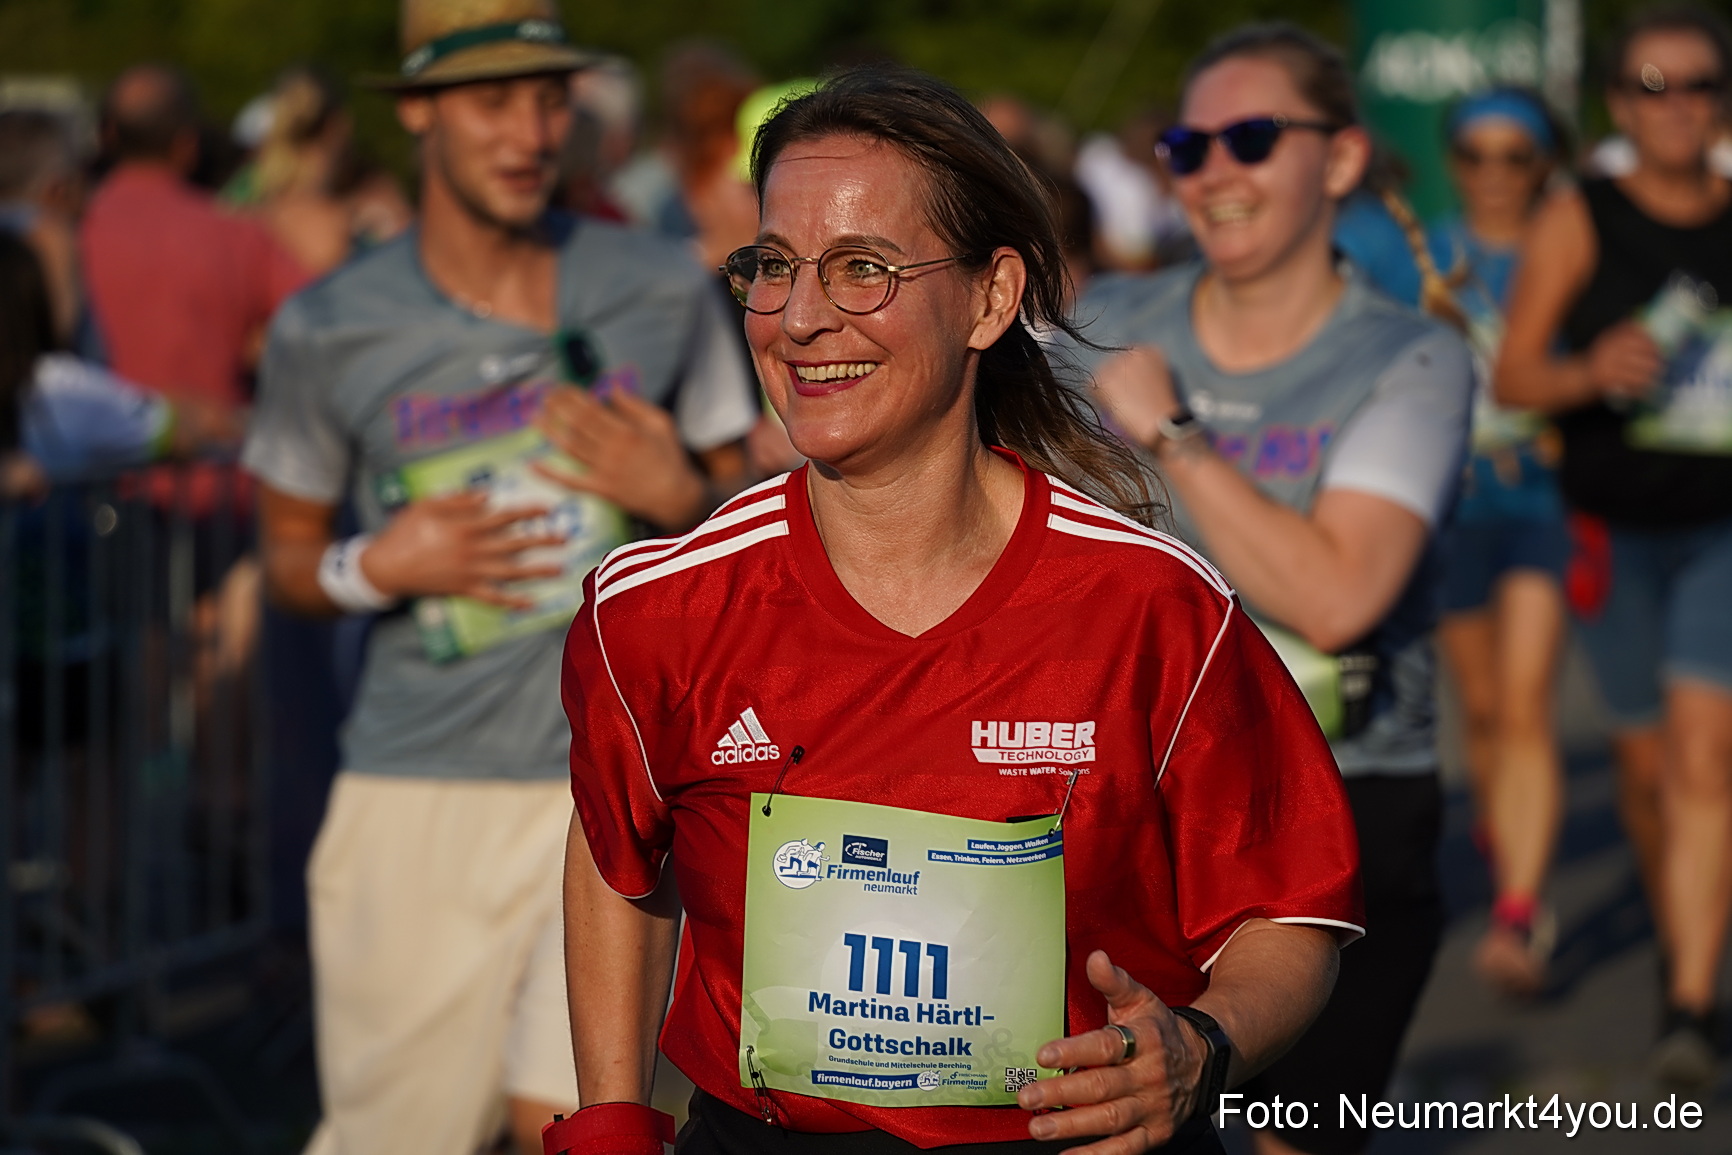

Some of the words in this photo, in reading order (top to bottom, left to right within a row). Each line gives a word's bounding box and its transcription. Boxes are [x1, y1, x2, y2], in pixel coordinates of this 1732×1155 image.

[971, 721, 1096, 749] HUBER
[711, 743, 780, 765] adidas
[998, 750, 1090, 761] TECHNOLOGY
[999, 768, 1027, 776] WASTE
[1030, 767, 1056, 776] WATER
[852, 847, 885, 858] Fischer
[971, 842, 996, 851] Laufen,
[997, 842, 1023, 852] Joggen,
[1024, 838, 1049, 848] Walken
[931, 852, 953, 861] Essen,
[954, 854, 981, 863] Trinken,
[1006, 852, 1046, 864] Netzwerken
[827, 864, 920, 885] Firmenlauf
[863, 883, 918, 895] neumarkt
[844, 932, 949, 1000] 1111
[808, 991, 910, 1023] Martina
[916, 1002, 995, 1026] Härtl-
[829, 1028, 972, 1056] Gottschalk
[828, 1055, 874, 1067] Grundschule
[891, 1061, 937, 1069] Mittelschule
[938, 1062, 972, 1070] Berching
[817, 1073, 913, 1089] firmenlauf.bayern
[942, 1078, 988, 1086] Firmenlauf
